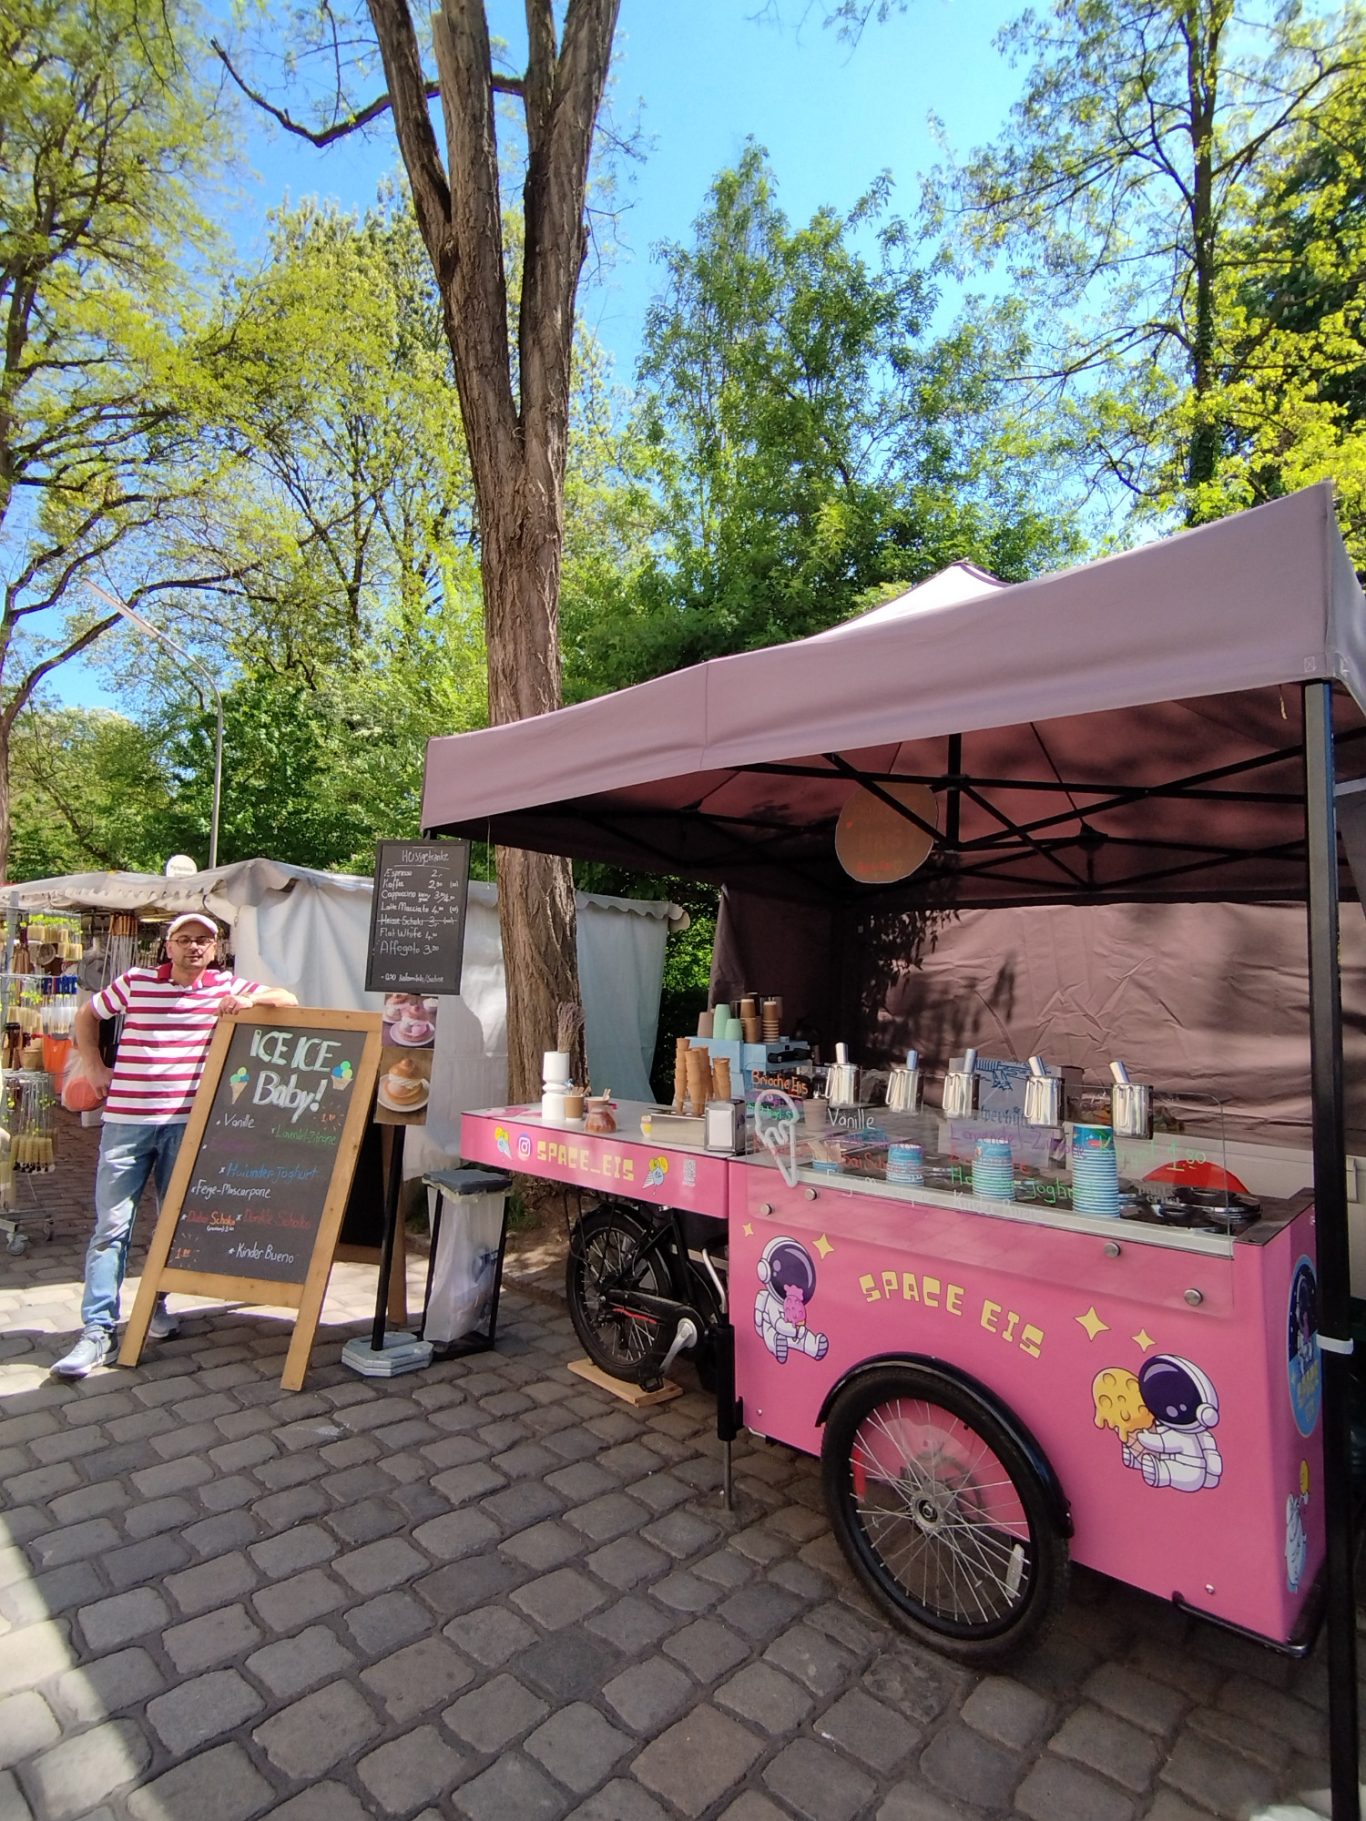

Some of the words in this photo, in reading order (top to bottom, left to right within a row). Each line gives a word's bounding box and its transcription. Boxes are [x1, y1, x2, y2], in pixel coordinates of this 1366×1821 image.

[379, 928, 395, 937] Flat
[397, 927, 422, 939] White
[250, 1029, 293, 1066] ICE
[291, 1037, 342, 1073] ICE
[752, 1069, 791, 1090] Brioche
[253, 1070, 329, 1124] Baby!
[224, 1112, 257, 1129] Vanille
[827, 1108, 877, 1130] Vanille
[236, 1241, 264, 1260] Kinder
[265, 1244, 295, 1264] Bueno
[858, 1271, 964, 1312] SPACE
[980, 1299, 1045, 1359] EIS
